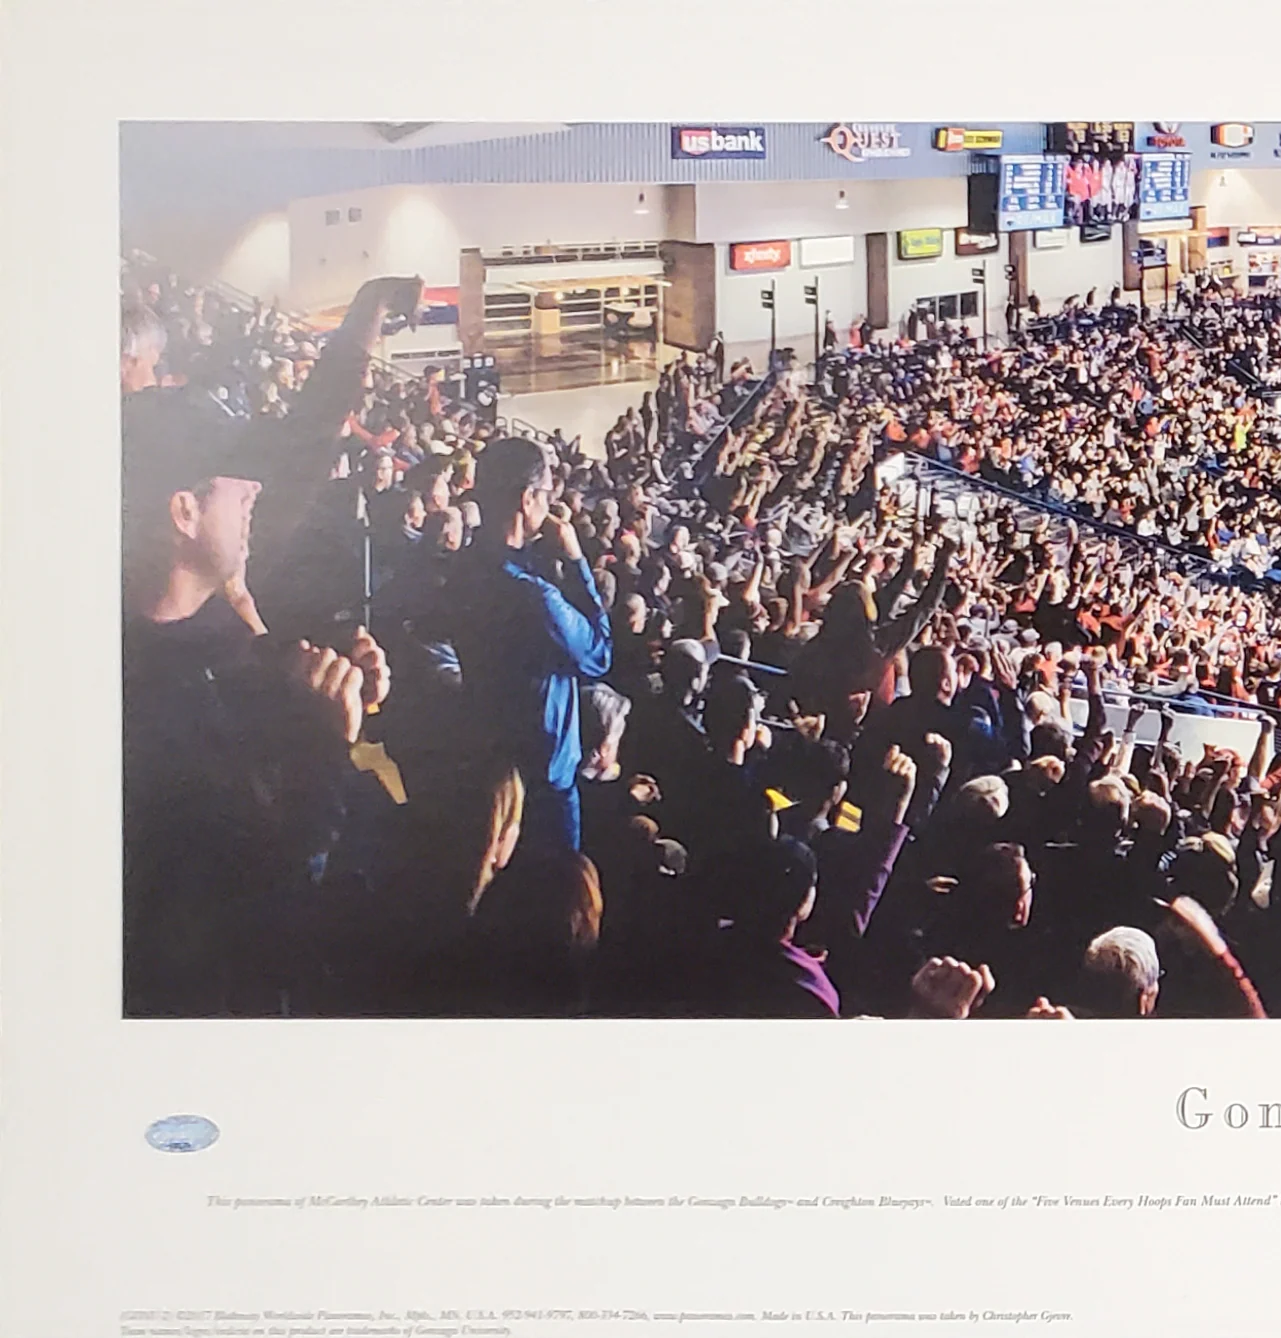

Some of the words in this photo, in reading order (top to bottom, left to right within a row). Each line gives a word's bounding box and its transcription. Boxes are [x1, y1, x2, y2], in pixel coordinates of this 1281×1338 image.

[683, 131, 763, 151] usbank
[943, 1194, 972, 1207] Voted
[975, 1198, 994, 1207] one
[997, 1194, 1008, 1211] of
[1011, 1194, 1028, 1207] the
[1062, 1194, 1100, 1207] Venues
[1104, 1193, 1134, 1210] Every
[1138, 1193, 1172, 1210] Hoops
[1176, 1193, 1197, 1206] Fan
[1202, 1193, 1230, 1206] Must
[982, 1310, 1038, 1323] Christopher
